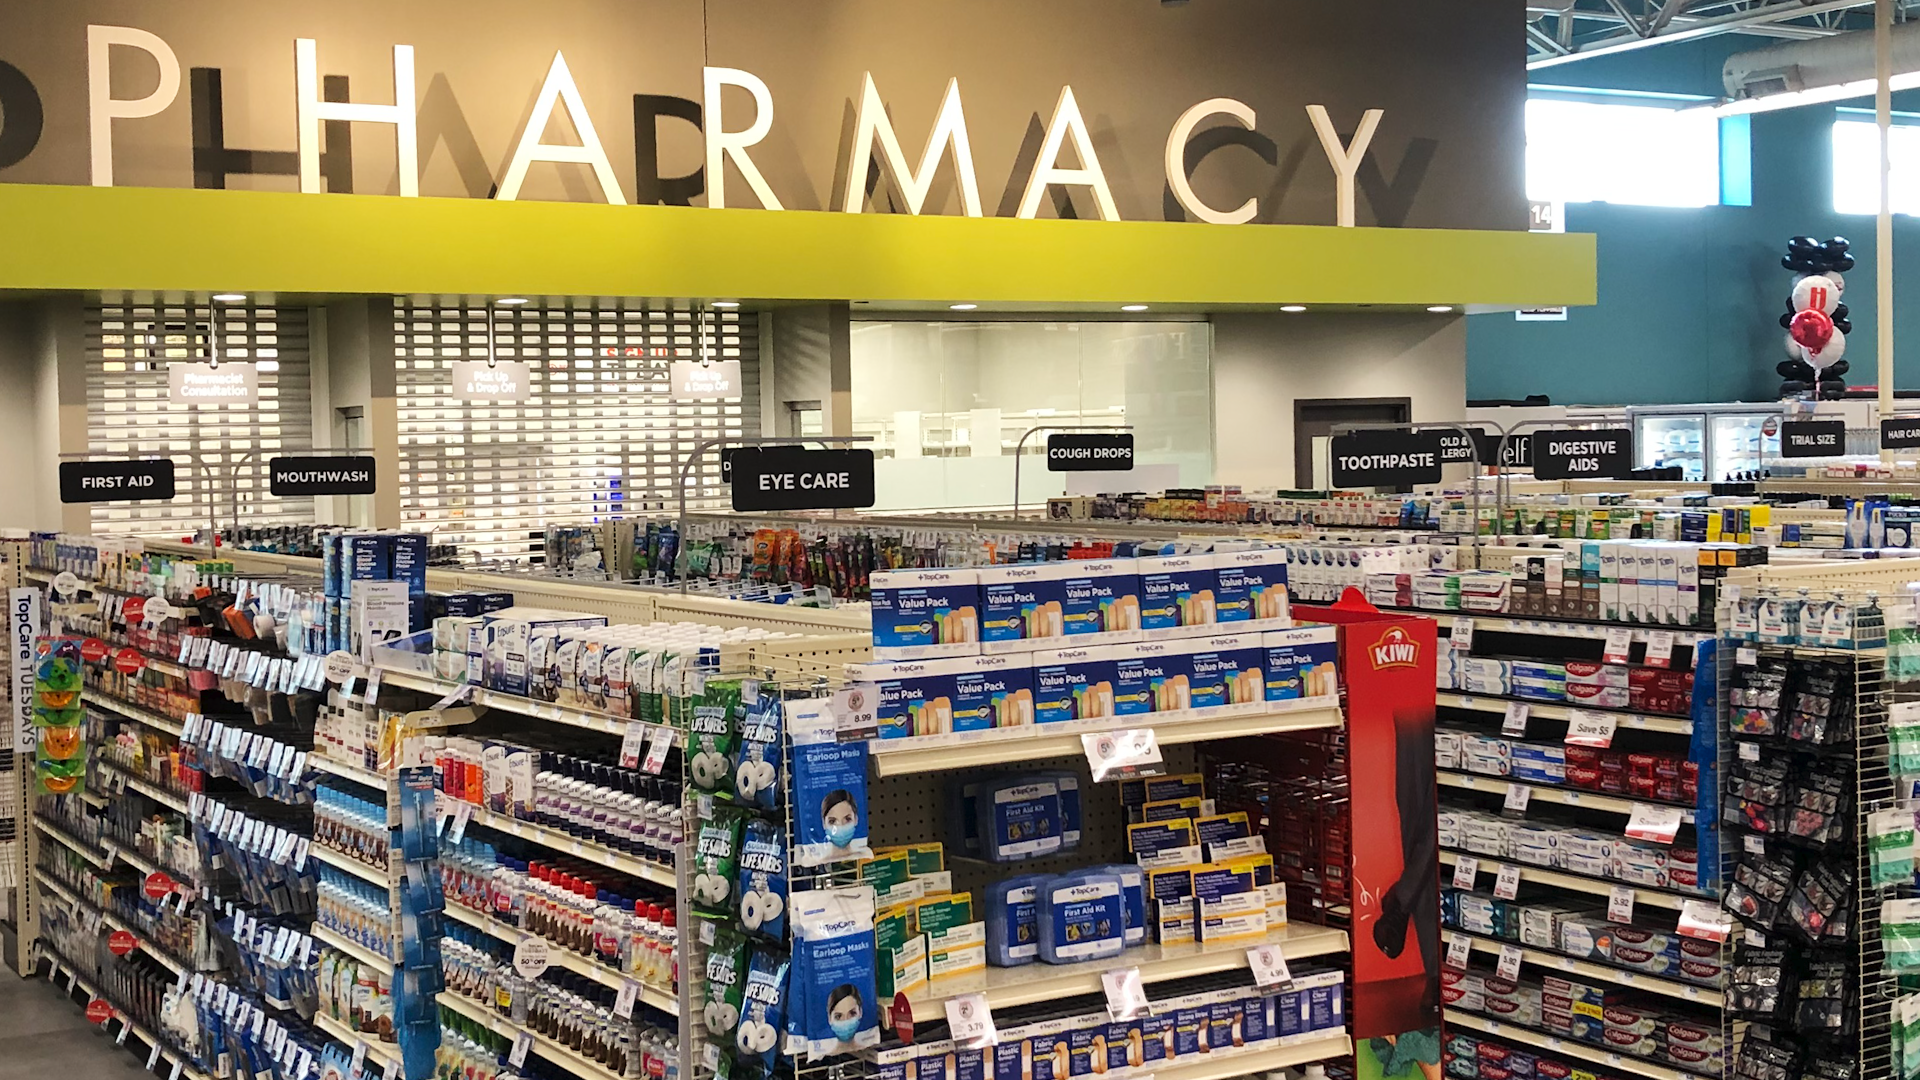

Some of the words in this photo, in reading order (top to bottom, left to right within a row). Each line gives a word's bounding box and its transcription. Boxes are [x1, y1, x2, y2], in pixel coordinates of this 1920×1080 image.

[87, 24, 1385, 228] PHARMACY
[1531, 204, 1551, 224] 14
[184, 373, 244, 385] Pharmacist
[473, 370, 492, 382] Pick
[494, 371, 509, 384] Up
[180, 384, 248, 397] Consultation
[466, 384, 474, 393] &
[475, 383, 499, 395] Drop
[501, 381, 517, 393] Off
[692, 382, 714, 394] Drop
[715, 380, 729, 392] Off
[1791, 434, 1815, 445] TRIAL
[1817, 433, 1836, 445] SIZE
[1888, 430, 1905, 439] HAIR
[1906, 428, 1920, 438] CAR
[1440, 436, 1459, 447] OLD
[1460, 436, 1468, 446] &
[1050, 448, 1091, 459] COUGH
[1093, 447, 1132, 459] DROPS
[1441, 447, 1472, 459] LERGY
[1503, 438, 1528, 465] elf
[1549, 441, 1616, 456] DIGESTIVE
[1339, 452, 1435, 470] TOOTHPASTE
[1568, 458, 1600, 472] AIDS
[82, 476, 122, 489] FIRST
[128, 475, 154, 488] AID
[276, 470, 369, 484] MOUTHWASH
[759, 474, 795, 490] EYE
[799, 472, 849, 489] CARE
[923, 573, 950, 581] TopCare
[1010, 569, 1037, 577] TopCare
[1219, 578, 1242, 587] Value
[1243, 576, 1263, 585] Pack
[1066, 589, 1090, 598] Value
[1092, 586, 1113, 596] Pack
[1145, 584, 1169, 594] Value
[1170, 582, 1190, 591] Pack
[898, 598, 925, 609] Value
[926, 597, 949, 607] Pack
[988, 594, 1013, 604] Value
[1014, 593, 1035, 602] Pack
[15, 595, 32, 660] TopCare
[1455, 627, 1469, 636] 5.92
[1140, 644, 1164, 652] TopCare
[1375, 643, 1415, 665] KIWI
[1063, 651, 1087, 659] TopCare
[1270, 656, 1293, 666] Value
[1293, 654, 1312, 664] Pack
[981, 657, 1006, 666] TopCare
[1194, 663, 1217, 673] Value
[1218, 660, 1238, 670] Pack
[1567, 662, 1597, 673] Colgate
[898, 664, 925, 673] TopCare
[1118, 669, 1142, 679] Value
[1143, 667, 1164, 677] Pack
[1040, 676, 1065, 686] Value
[1065, 673, 1086, 683] Pack
[957, 684, 983, 694] Value
[984, 681, 1005, 691] Pack
[1567, 684, 1598, 695] Colgate
[880, 690, 900, 700] alue
[901, 688, 924, 698] Pack
[20, 664, 35, 745] TUESDAYS
[854, 713, 872, 723] 8.99
[1577, 722, 1597, 734] Save
[1598, 725, 1610, 735] $5
[806, 753, 840, 762] Earloop
[1628, 754, 1653, 764] Colgate
[1567, 768, 1597, 779] Colgate
[1016, 786, 1039, 795] TopCare
[1006, 809, 1022, 817] First
[1035, 804, 1045, 812] Kit
[1458, 865, 1473, 875] 5.92
[1500, 874, 1515, 884] 5.92
[1075, 886, 1100, 895] TopCare
[1614, 896, 1629, 907] 5.92
[1016, 909, 1031, 917] First
[1064, 909, 1081, 917] First
[1082, 907, 1094, 915] Aid
[1095, 904, 1106, 913] Kit
[825, 920, 856, 932] TopCare
[1616, 927, 1646, 941] Colgate
[813, 947, 846, 958] Earloop
[847, 942, 869, 953] Masks
[1452, 943, 1466, 953] 5.92
[1616, 947, 1647, 960] Colgate
[1503, 955, 1517, 966] 5.92
[1270, 969, 1284, 978] 4.99
[1682, 961, 1715, 975] Colgate
[1280, 997, 1296, 1006] Clear
[1312, 991, 1327, 1000] Clear
[1245, 1003, 1261, 1012] Clear
[1486, 998, 1519, 1010] Colgate
[1604, 1008, 1634, 1023] Colgate
[967, 1021, 984, 1032] 3.79
[1108, 1027, 1127, 1036] Fabric
[1669, 1025, 1701, 1040] Colgate
[1072, 1033, 1091, 1042] Fabric
[1604, 1027, 1635, 1041] Colgate
[1034, 1040, 1053, 1049] Fabric
[998, 1047, 1019, 1056] Plastic
[1478, 1044, 1505, 1058] Colgate
[1669, 1045, 1701, 1060] Colgate
[959, 1053, 980, 1063] Plastic
[921, 1061, 943, 1070] Plastic
[1479, 1064, 1508, 1078] Colgate
[1537, 1061, 1566, 1076] Colgate
